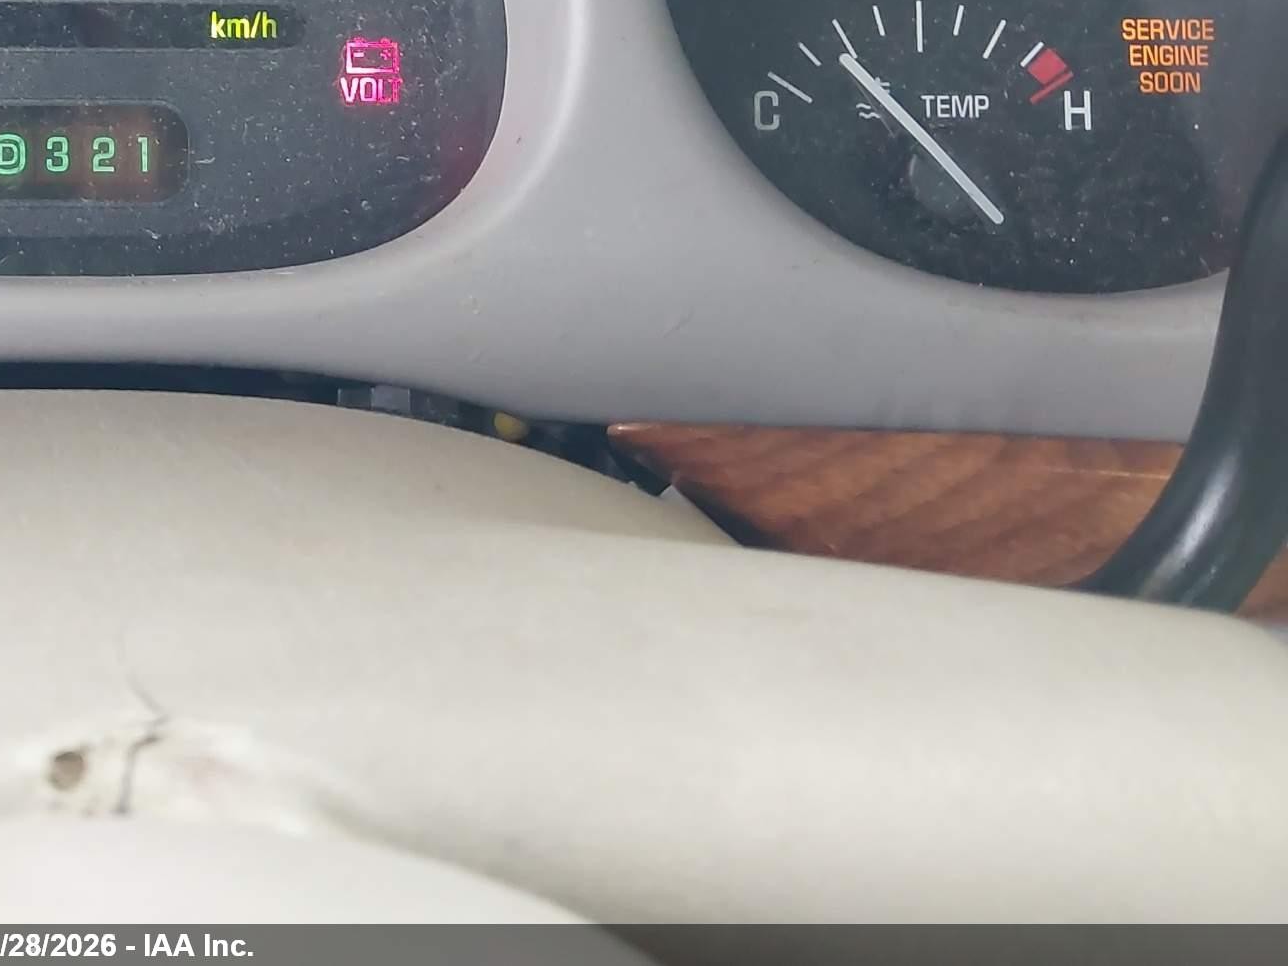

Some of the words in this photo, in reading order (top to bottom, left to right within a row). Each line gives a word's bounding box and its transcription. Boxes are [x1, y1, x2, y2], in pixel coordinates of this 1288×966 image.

[210, 11, 278, 40] km/h
[1122, 18, 1214, 41] SERVICE
[1129, 44, 1209, 67] ENGINE
[339, 77, 404, 104] VOLT
[1139, 71, 1201, 93] SOON
[753, 90, 782, 132] C
[920, 94, 990, 119] TEMP
[1063, 90, 1092, 131] H
[45, 136, 70, 173] 3
[92, 136, 116, 173] 2
[137, 136, 150, 173] 1
